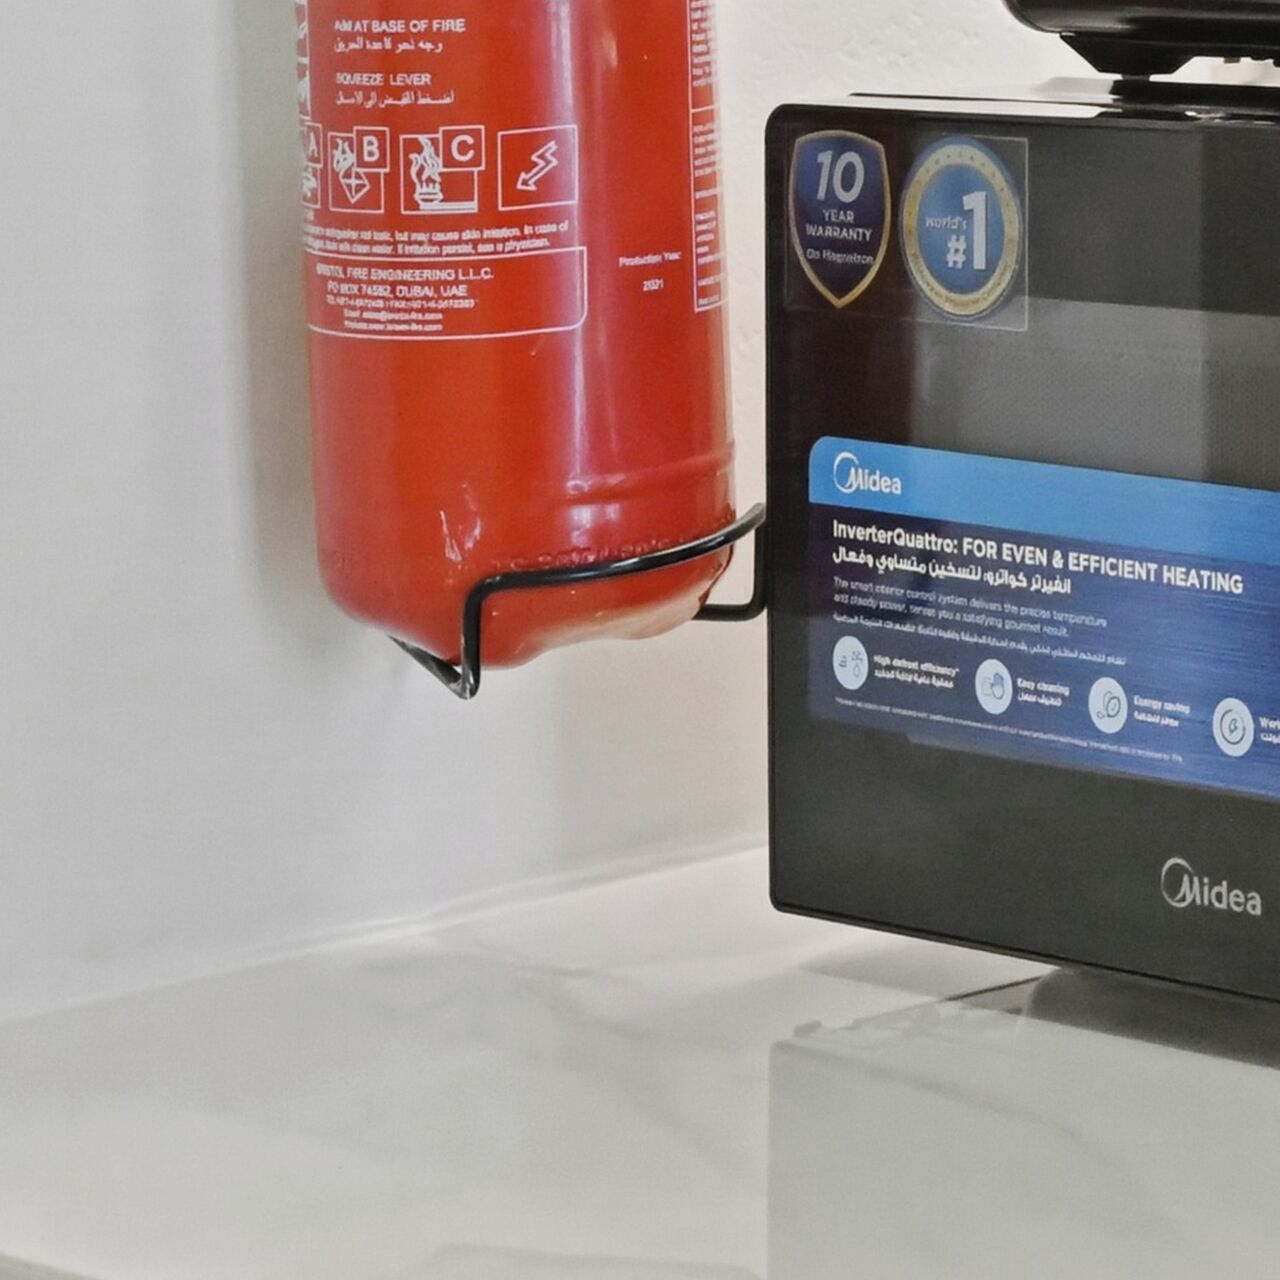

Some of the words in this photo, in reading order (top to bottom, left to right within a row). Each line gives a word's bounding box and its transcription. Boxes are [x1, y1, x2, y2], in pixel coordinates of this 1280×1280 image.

[354, 20, 369, 33] AT
[372, 20, 405, 33] BASE
[410, 20, 429, 33] OF
[432, 18, 466, 32] FIRE
[336, 72, 384, 86] SQUEEZE
[390, 73, 432, 86] LEVER
[308, 132, 318, 157] A
[363, 135, 379, 162] B
[450, 135, 475, 162] C
[817, 150, 865, 203] 10
[823, 209, 855, 223] YEAR
[806, 223, 872, 241] WARRANTY
[946, 191, 987, 270] #1
[347, 267, 369, 279] FIRE
[371, 268, 455, 281] ENGINEERING
[458, 267, 494, 280] L.L.C.
[441, 284, 468, 297] UAE
[833, 451, 902, 496] Midea
[833, 519, 959, 554] InverterQuattro:
[963, 537, 997, 560] FOR
[1002, 543, 1047, 567] EVEN
[1052, 550, 1064, 569] &
[1068, 552, 1158, 581] EFFICIENT
[1163, 565, 1244, 594] HEATING
[833, 577, 849, 589] The
[937, 592, 968, 607] system
[1004, 603, 1019, 614] the
[1017, 677, 1036, 691] Easy
[1133, 695, 1163, 709] Energy
[1161, 857, 1262, 916] Midea
